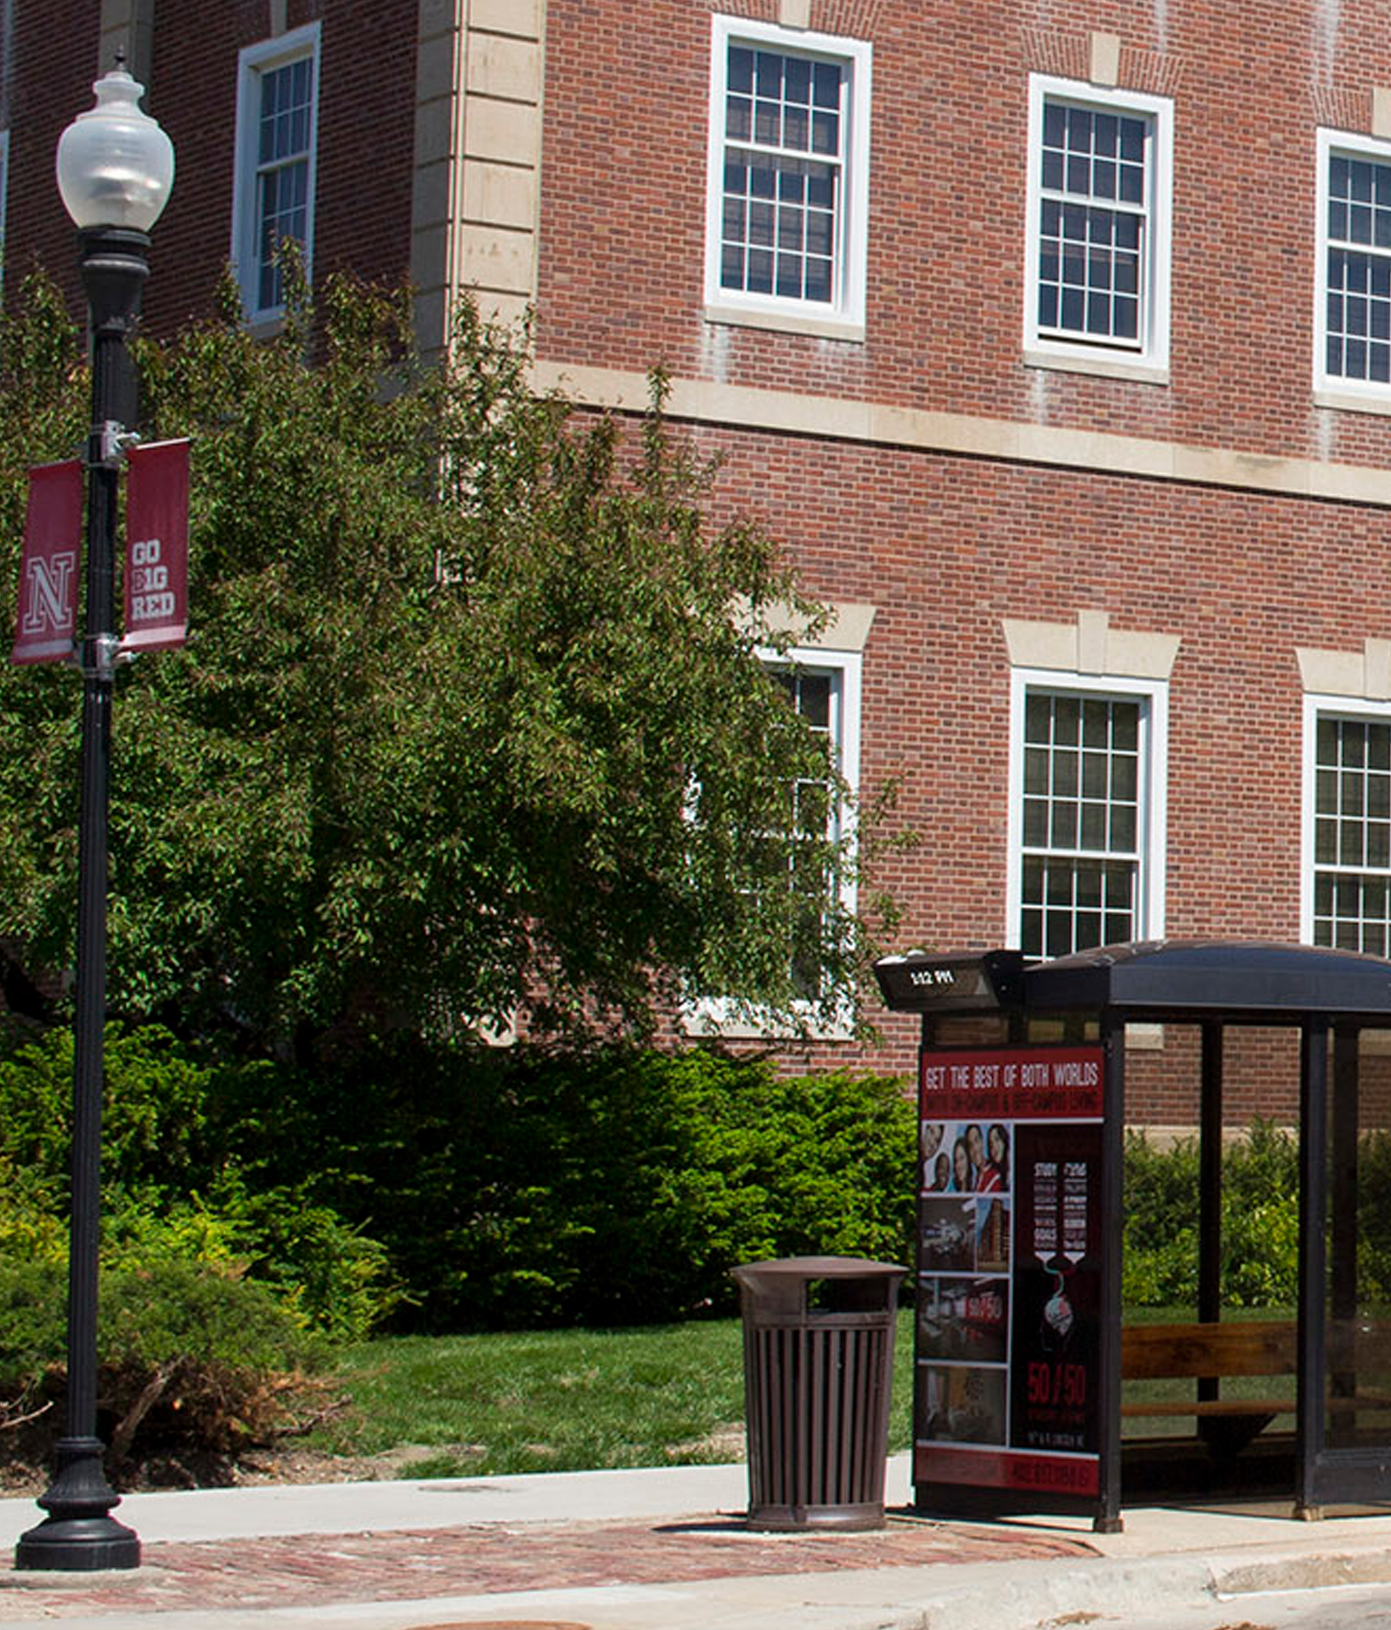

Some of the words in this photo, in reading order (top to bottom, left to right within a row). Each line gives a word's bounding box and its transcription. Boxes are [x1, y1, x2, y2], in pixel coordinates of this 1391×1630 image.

[132, 539, 161, 565] GO
[22, 552, 75, 634] N
[131, 565, 168, 594] BIG
[131, 591, 175, 622] RED
[925, 1066, 947, 1090] GET
[950, 1066, 970, 1089] THE
[974, 1065, 1000, 1089] BEST
[1004, 1064, 1017, 1088] OF
[1021, 1063, 1049, 1088] BOTH
[1053, 1062, 1099, 1087] WORLDS
